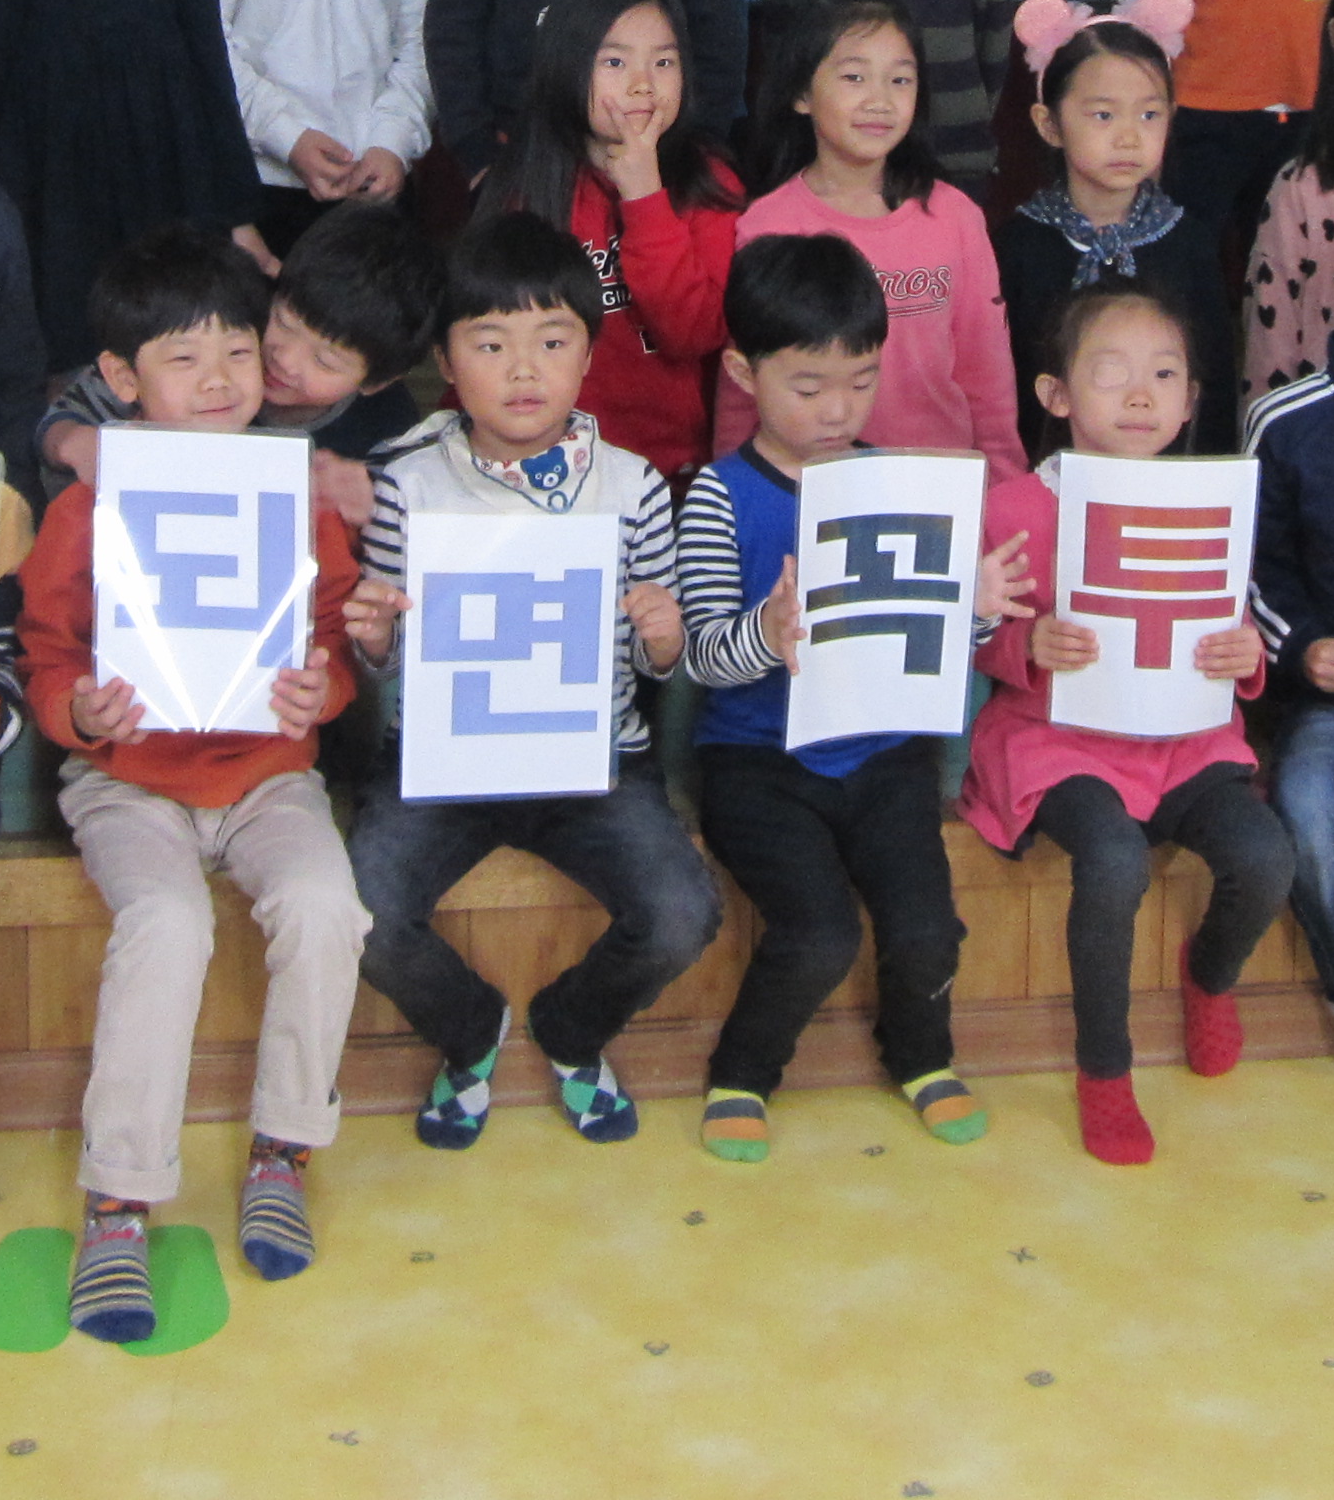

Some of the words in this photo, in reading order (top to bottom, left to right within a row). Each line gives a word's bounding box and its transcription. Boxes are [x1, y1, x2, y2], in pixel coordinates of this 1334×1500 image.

[114, 489, 296, 669] 되
[420, 568, 604, 737] 면
[805, 513, 961, 676] 꼭
[1069, 501, 1237, 671] 투
